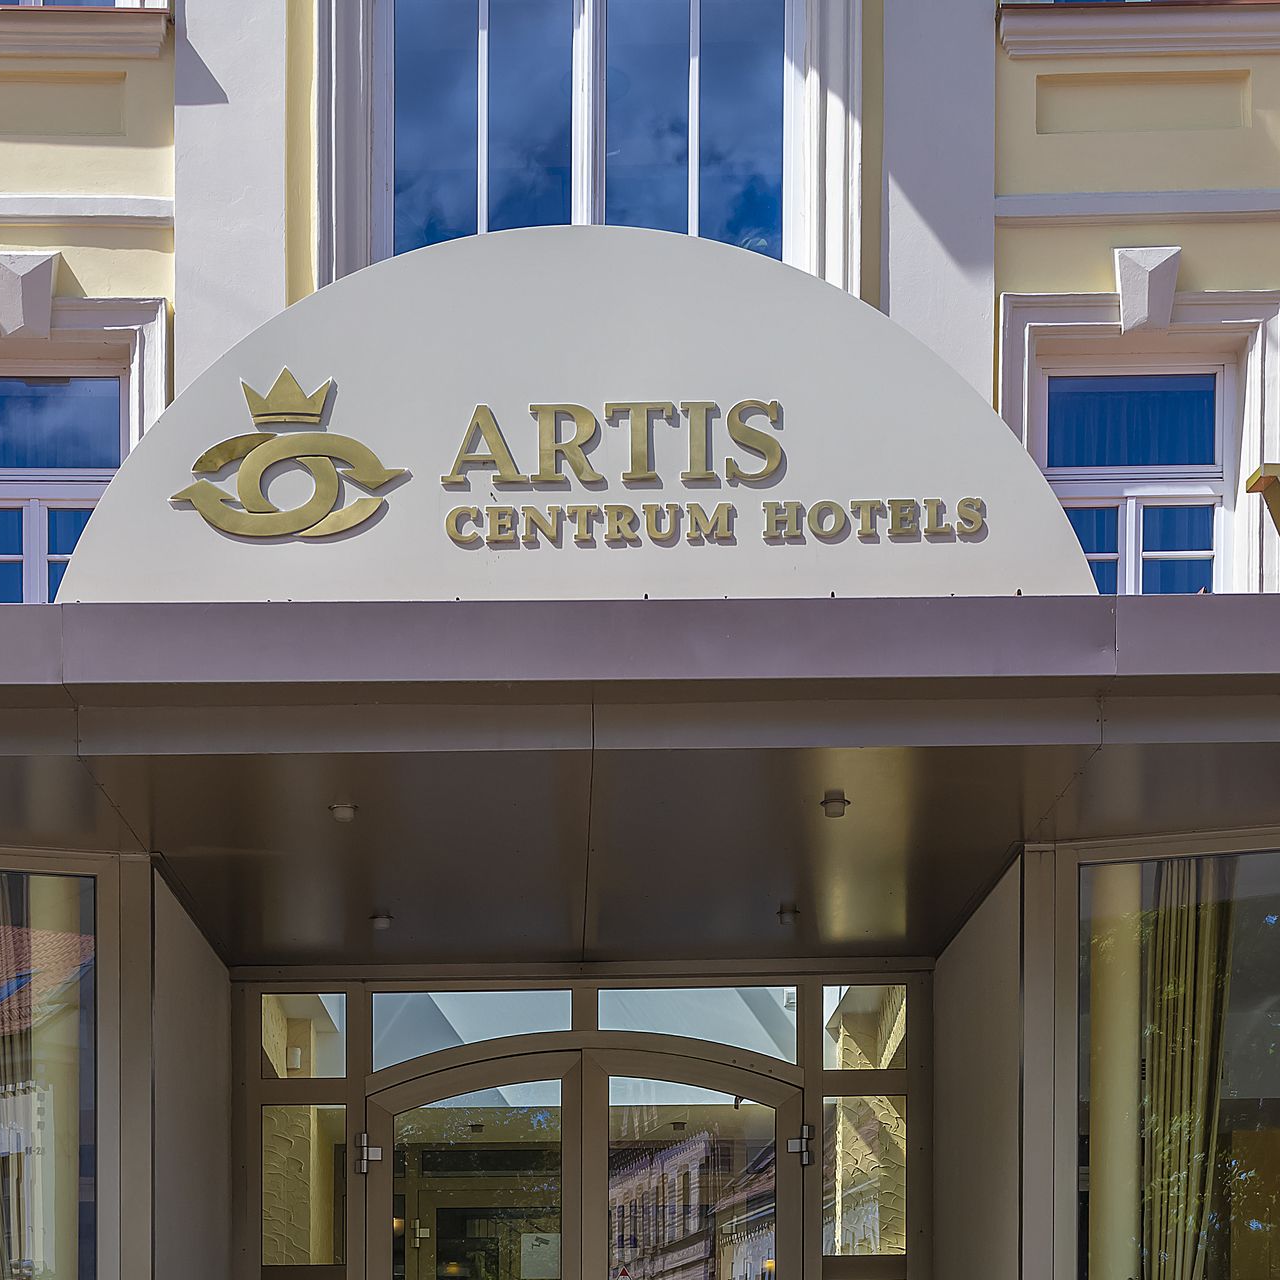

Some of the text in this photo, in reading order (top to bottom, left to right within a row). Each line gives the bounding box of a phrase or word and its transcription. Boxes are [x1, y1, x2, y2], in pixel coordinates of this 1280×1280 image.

[439, 398, 785, 488] ARTIS
[444, 497, 990, 547] CENTRUM HOTELS
